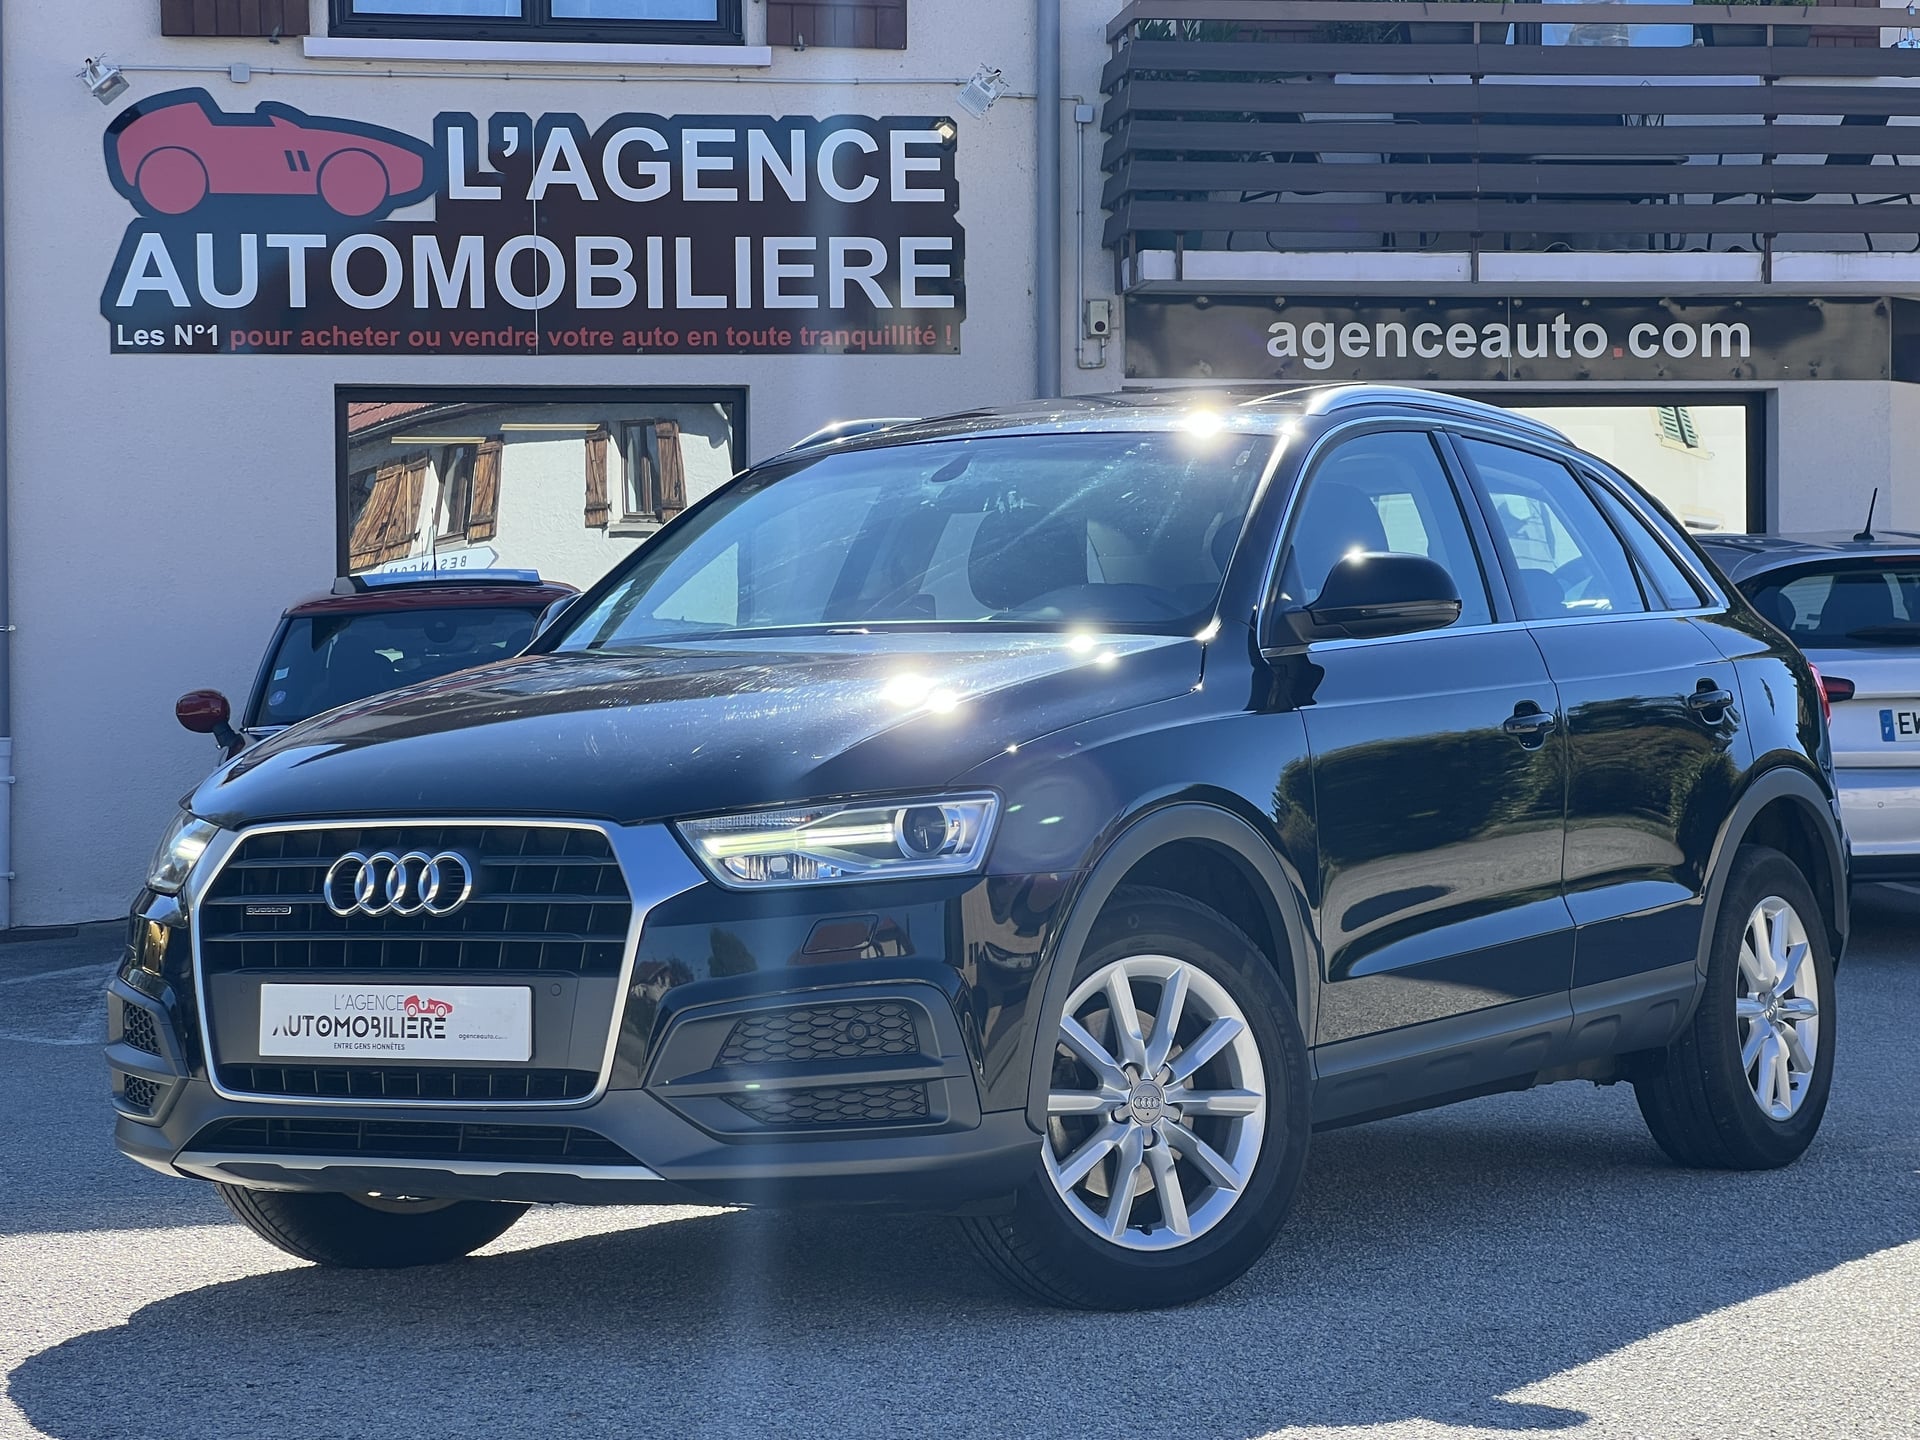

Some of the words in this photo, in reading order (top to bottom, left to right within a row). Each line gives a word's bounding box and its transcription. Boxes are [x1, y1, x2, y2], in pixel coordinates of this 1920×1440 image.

[448, 126, 947, 201] L'AGENCE
[116, 233, 956, 310] AUTOMOBILIERE
[117, 324, 165, 346] Les
[174, 324, 219, 346] N°1
[230, 330, 293, 350] pour
[301, 326, 400, 346] acheter
[408, 330, 440, 346] ou
[450, 326, 539, 346] vendre
[548, 326, 614, 346] votre
[622, 326, 679, 346] auto
[687, 330, 718, 346] en
[726, 326, 792, 346] toute
[800, 325, 937, 350] tranquillité
[1267, 313, 1751, 370] agenceauto.com
[333, 994, 404, 1011] L'AGENCE
[333, 1042, 353, 1050] ENTRE
[372, 1042, 406, 1051] HONNÊTES
